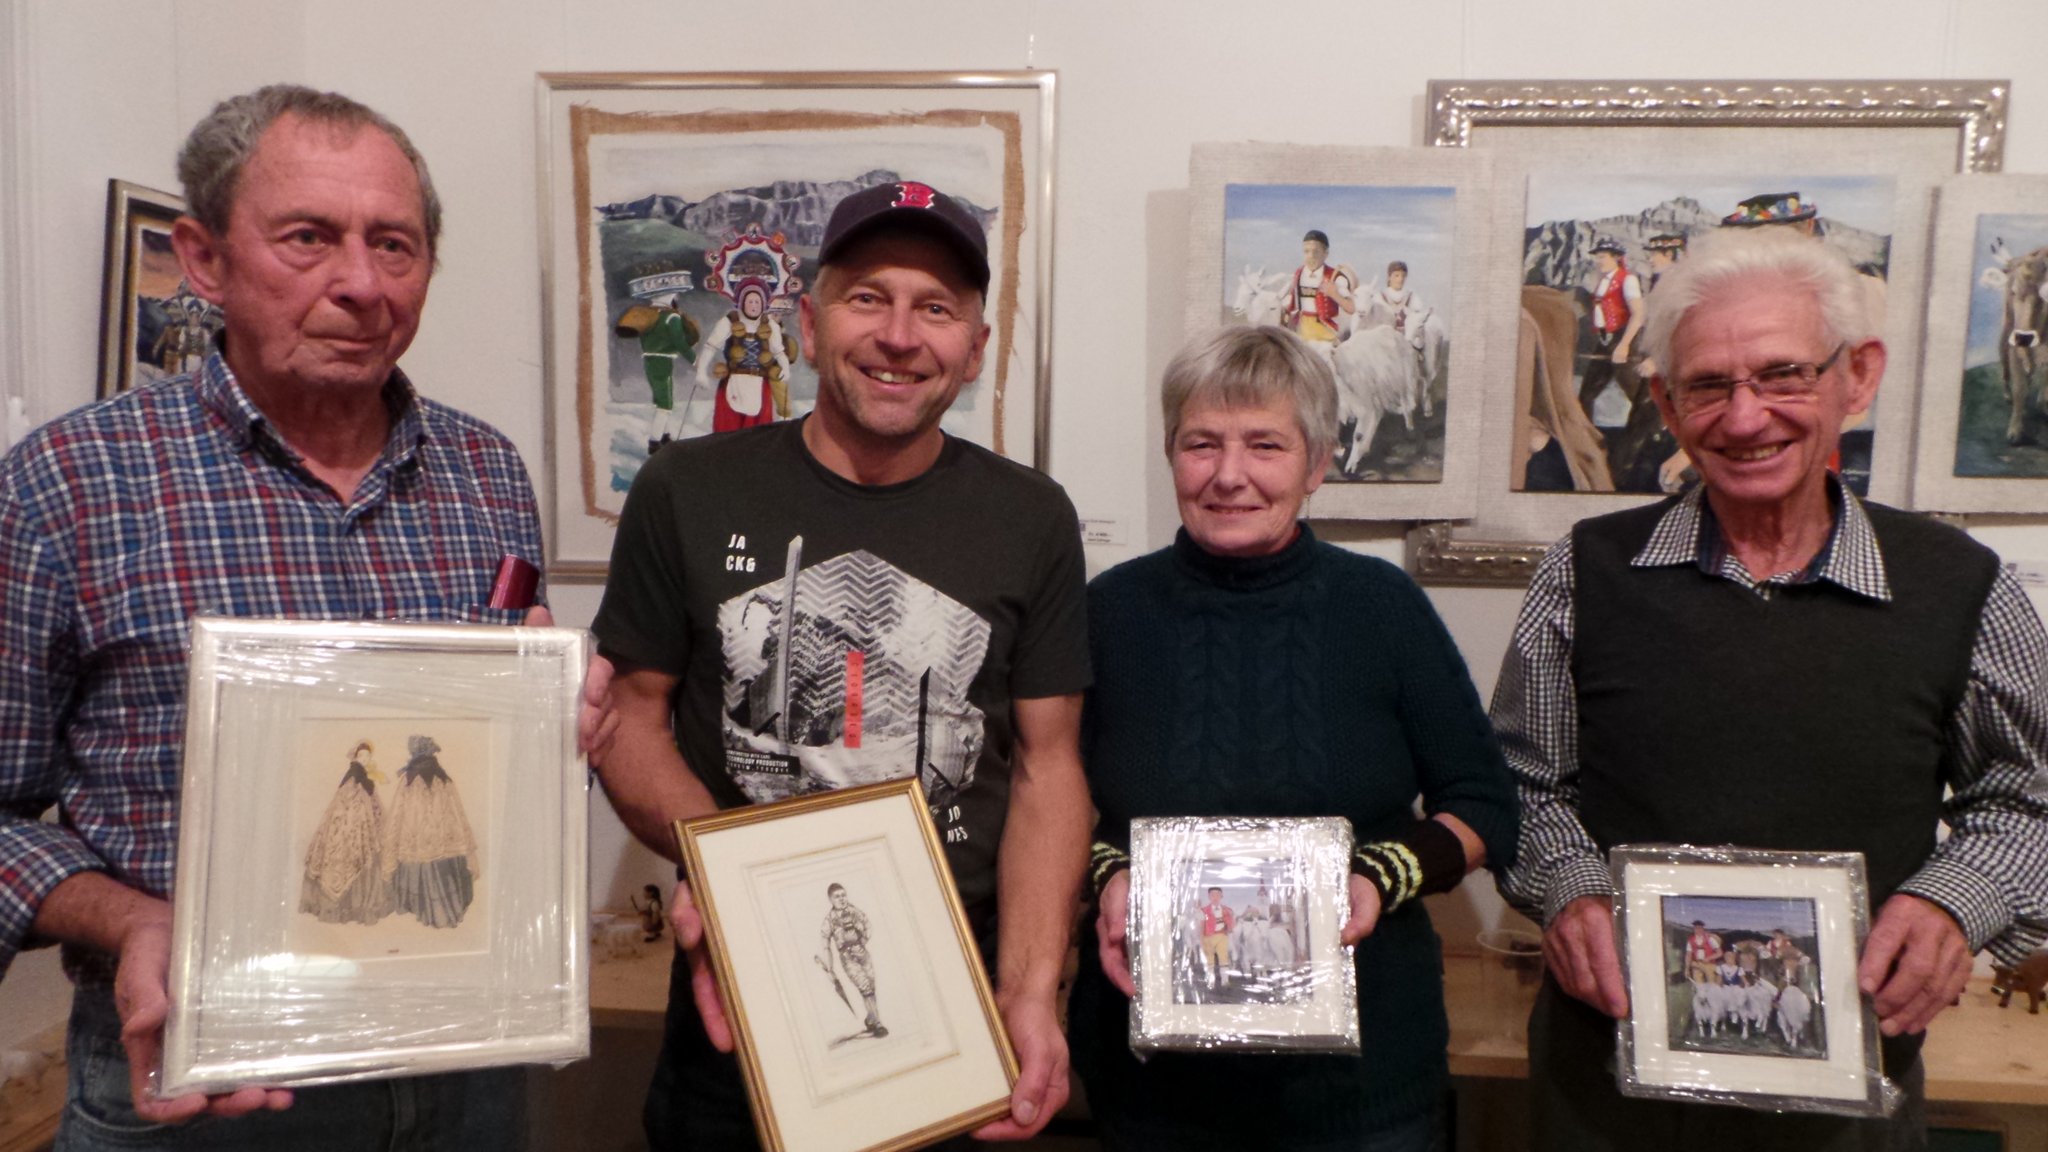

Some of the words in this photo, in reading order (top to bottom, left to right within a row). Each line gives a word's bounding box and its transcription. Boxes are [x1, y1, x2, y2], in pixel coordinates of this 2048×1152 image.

[728, 534, 745, 550] JA
[725, 555, 756, 572] CK&
[948, 805, 961, 824] JO
[947, 826, 969, 843] NES
